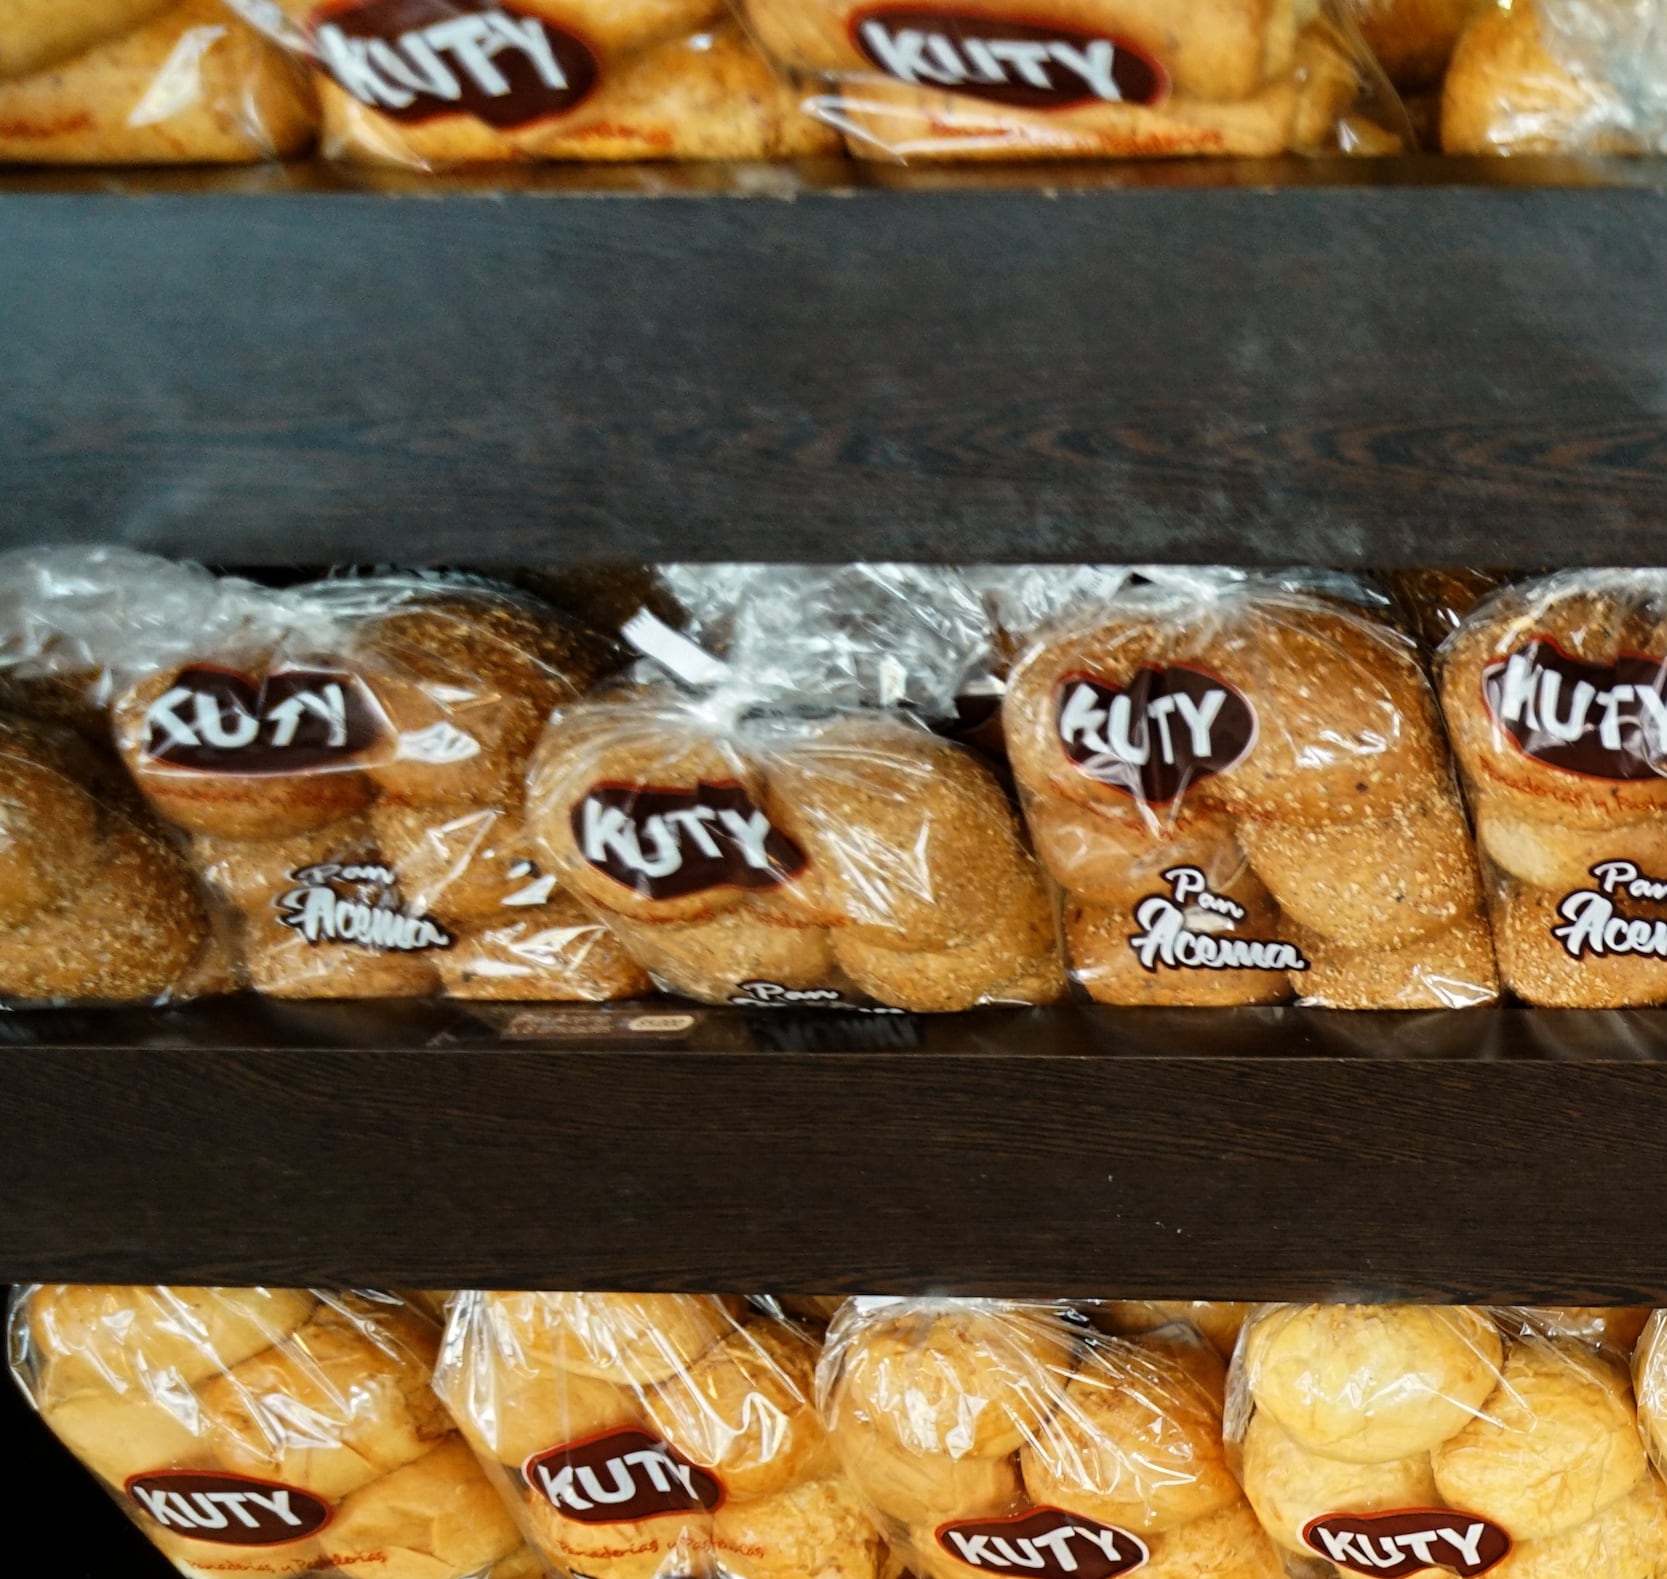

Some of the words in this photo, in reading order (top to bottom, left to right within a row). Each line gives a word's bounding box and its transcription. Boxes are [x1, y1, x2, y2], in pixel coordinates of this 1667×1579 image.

[316, 8, 569, 109] KUTY
[860, 19, 1123, 102] KUTY
[1060, 682, 1228, 766] KUTY
[583, 797, 770, 878] KUTY
[281, 886, 450, 950] Acema
[1164, 867, 1245, 919] Pan
[1131, 897, 1305, 969] Acema
[133, 1485, 302, 1529] KUTY
[537, 1450, 699, 1510] KUTY
[949, 1526, 1122, 1572] KUTY
[1316, 1523, 1485, 1568] KUTY
